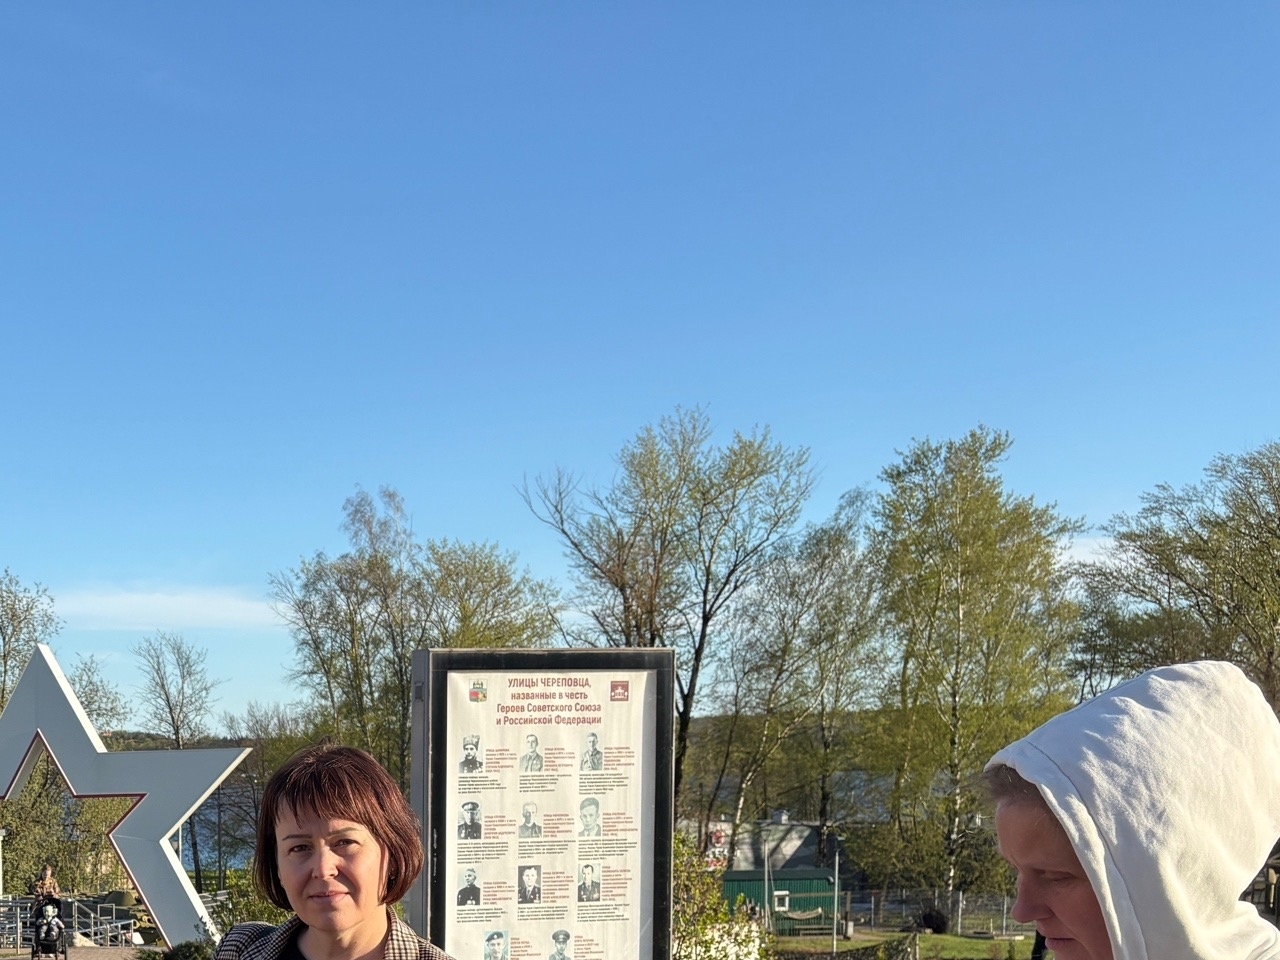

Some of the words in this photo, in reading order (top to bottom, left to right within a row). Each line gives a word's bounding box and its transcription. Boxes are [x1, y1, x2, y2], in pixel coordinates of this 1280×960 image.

[508, 678, 538, 688] УЛИЦЫ
[541, 677, 592, 688] ЧЕРЕПОВЦА,
[511, 692, 556, 700] названные
[565, 691, 588, 699] честь
[497, 704, 525, 714] Героев
[527, 703, 572, 712] Советского
[574, 702, 601, 712] Союза
[496, 717, 501, 725] и
[503, 715, 552, 725] Российской
[555, 714, 601, 726] Федерации
